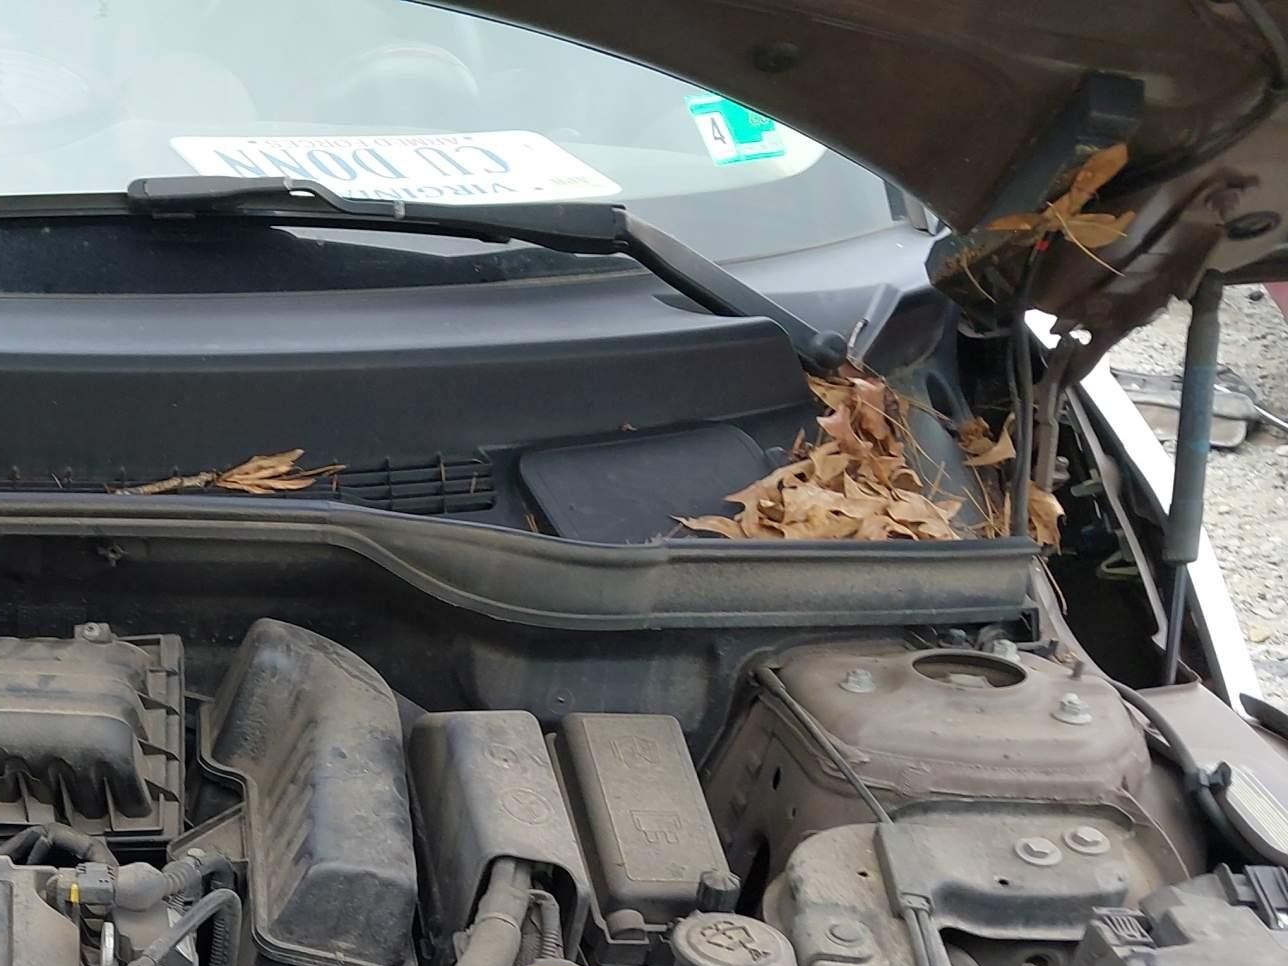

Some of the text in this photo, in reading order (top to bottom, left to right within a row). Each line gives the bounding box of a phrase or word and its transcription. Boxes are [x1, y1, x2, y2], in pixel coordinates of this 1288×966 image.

[264, 138, 369, 148] FORCES
[710, 117, 727, 144] 4
[213, 146, 511, 181] CU DONN
